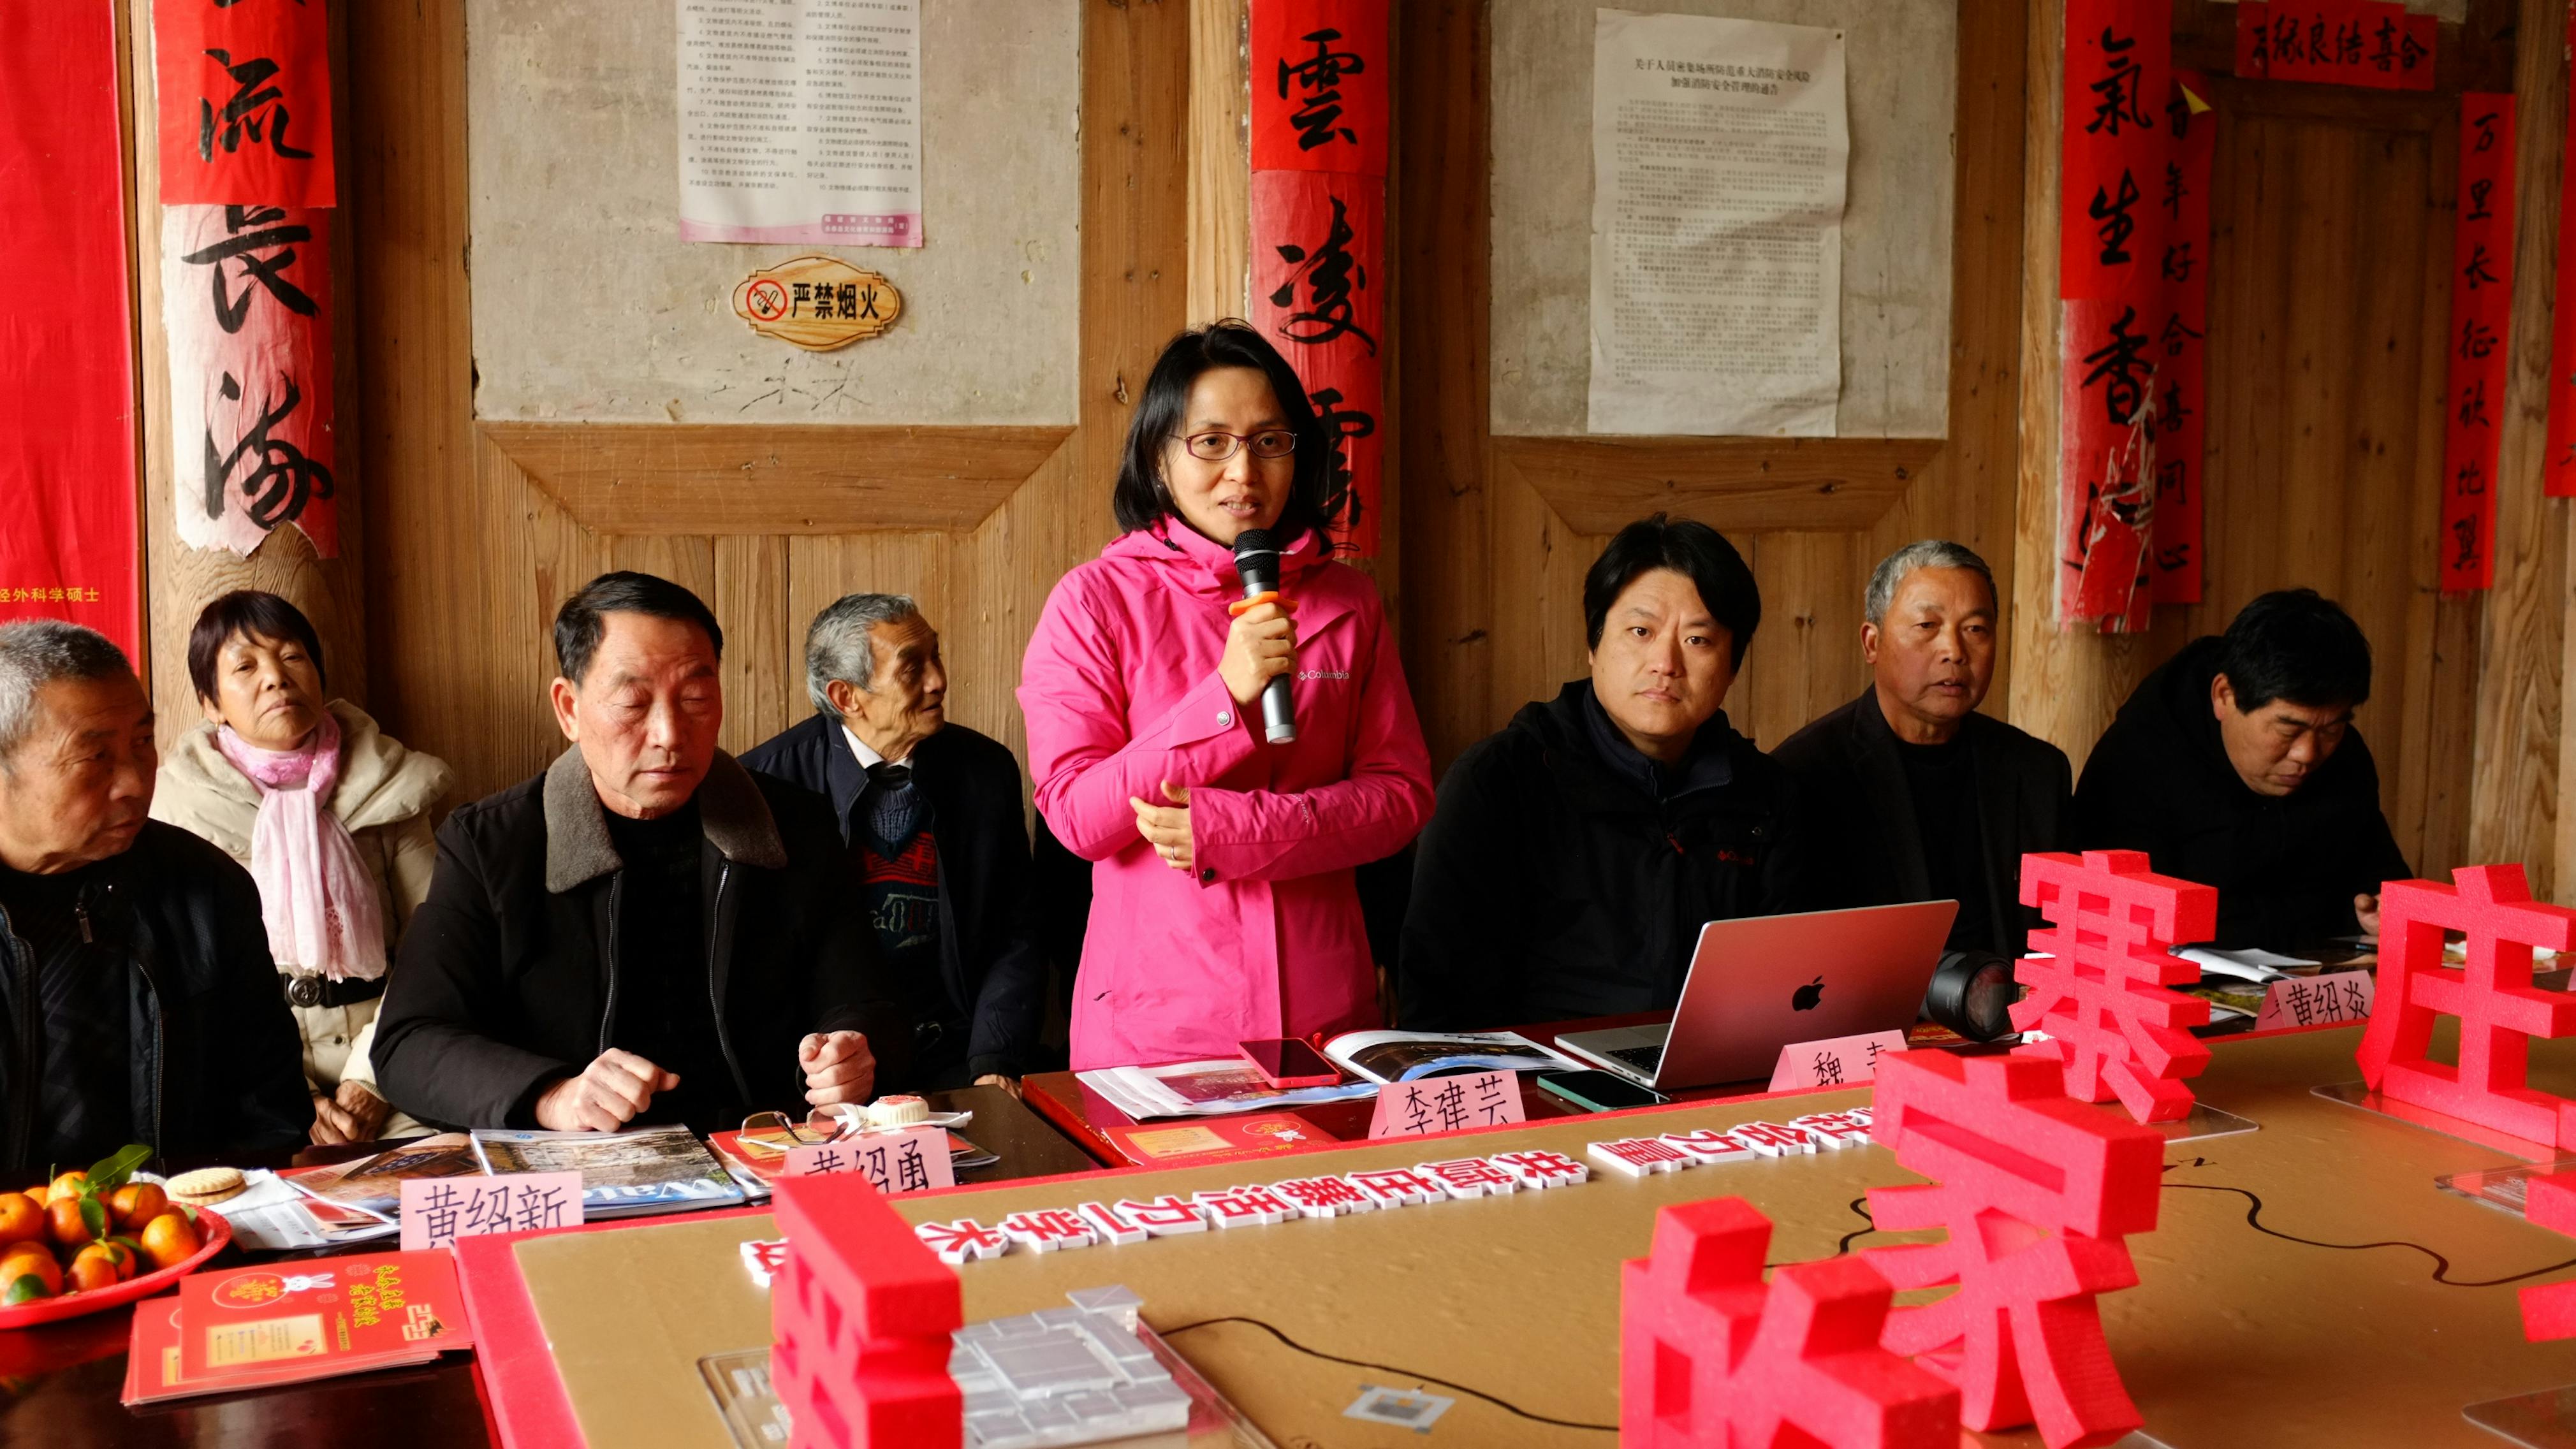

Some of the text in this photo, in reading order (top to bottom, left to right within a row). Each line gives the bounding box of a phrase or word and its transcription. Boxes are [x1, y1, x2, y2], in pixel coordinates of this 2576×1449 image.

[791, 282, 880, 320] 严禁烟火
[1308, 669, 1350, 680] Columbia
[2286, 980, 2370, 1026] 黄绍炎
[1404, 1075, 1508, 1135] 李建芸
[1593, 1106, 1874, 1169] 社会力量
[416, 1184, 567, 1250] 黄绍新
